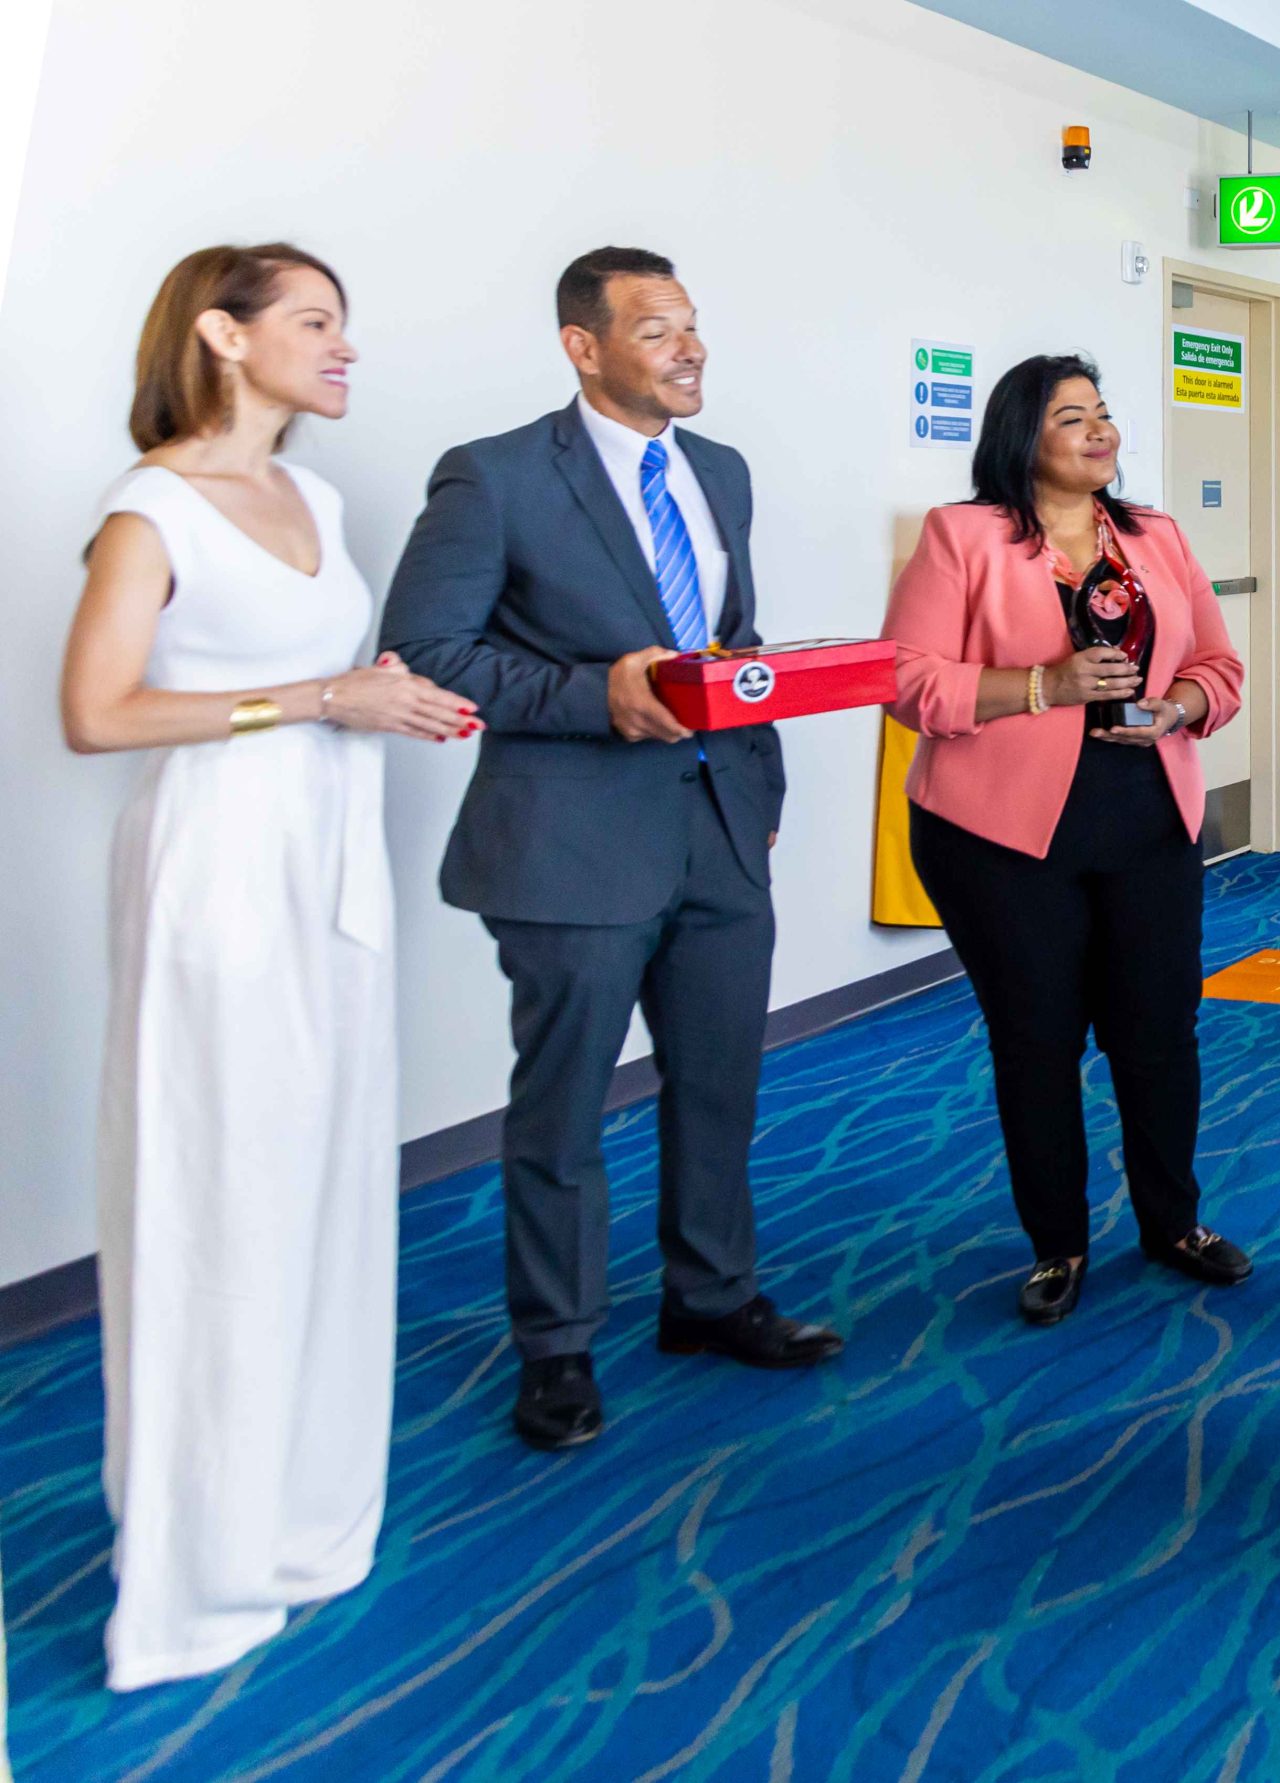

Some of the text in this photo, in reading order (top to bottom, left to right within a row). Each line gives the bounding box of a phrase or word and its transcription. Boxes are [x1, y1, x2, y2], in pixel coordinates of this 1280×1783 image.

[1182, 338, 1233, 357] Emergency Exit Only
[1181, 351, 1234, 368] Salida de emergencia
[1183, 375, 1233, 390] This door is alarmed
[1176, 387, 1187, 397] Esta
[1188, 389, 1205, 399] puerta
